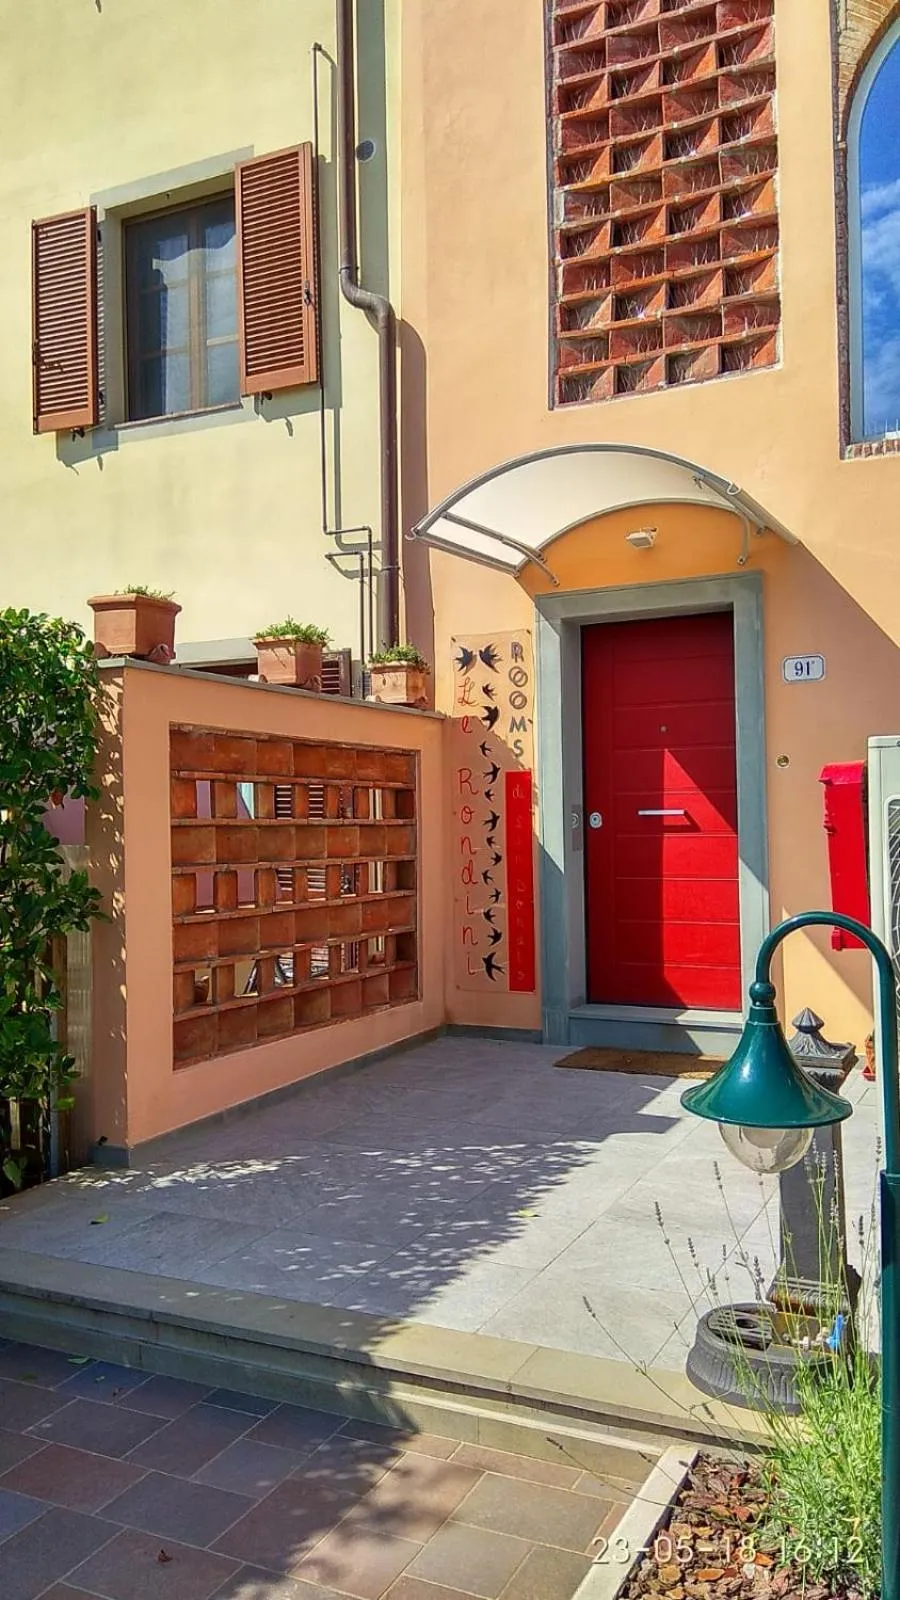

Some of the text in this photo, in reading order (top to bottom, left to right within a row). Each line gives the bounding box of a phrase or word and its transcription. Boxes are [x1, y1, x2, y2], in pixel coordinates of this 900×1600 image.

[508, 641, 529, 758] ROOMS
[457, 676, 480, 975] Le Rondini
